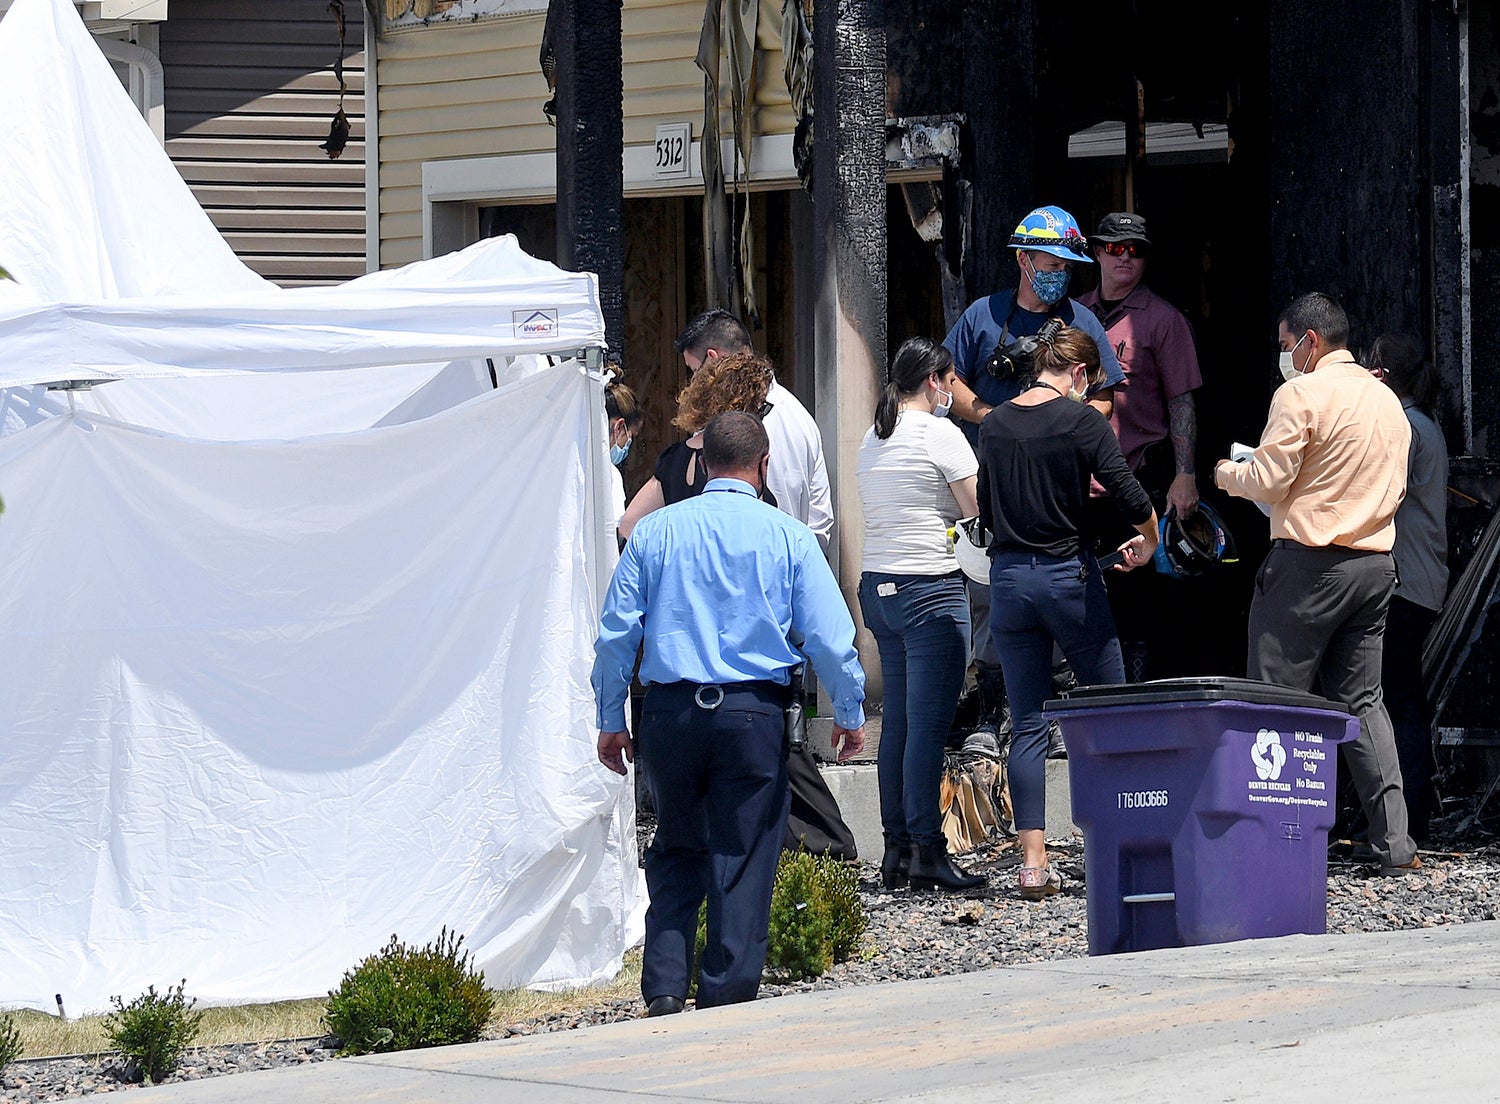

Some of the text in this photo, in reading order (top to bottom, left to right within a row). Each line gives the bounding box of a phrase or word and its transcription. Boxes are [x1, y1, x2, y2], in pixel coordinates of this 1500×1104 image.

[656, 137, 683, 167] 5312
[523, 323, 552, 332] IMPACT
[1295, 731, 1305, 741] NO
[1293, 748, 1325, 760] Recyclables
[1303, 761, 1317, 774] Only
[1248, 781, 1291, 791] DENVER RECYCLES
[1296, 778, 1325, 790] No Basura
